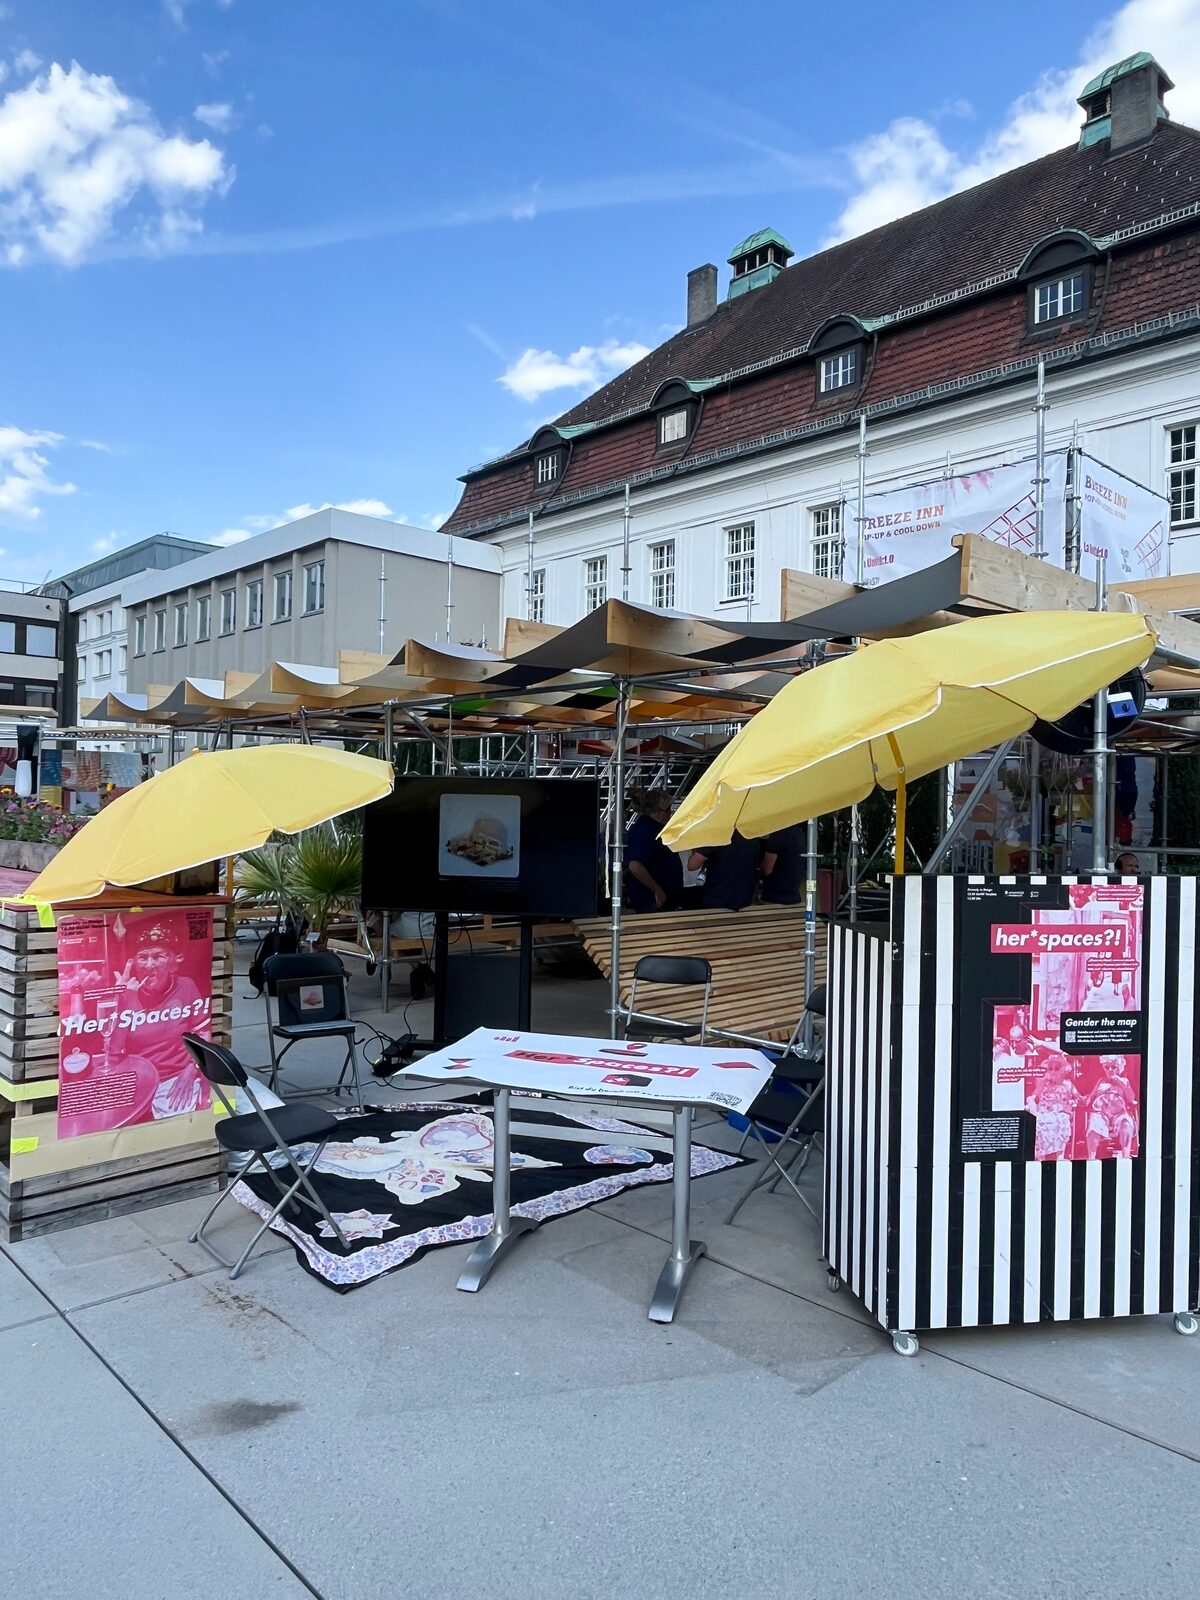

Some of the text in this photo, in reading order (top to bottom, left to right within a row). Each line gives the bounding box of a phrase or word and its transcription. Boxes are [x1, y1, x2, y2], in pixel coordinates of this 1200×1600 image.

[916, 504, 945, 520] INN
[864, 520, 941, 541] P-UP & COOL DOWN
[1065, 1017, 1138, 1028] Gender the map
